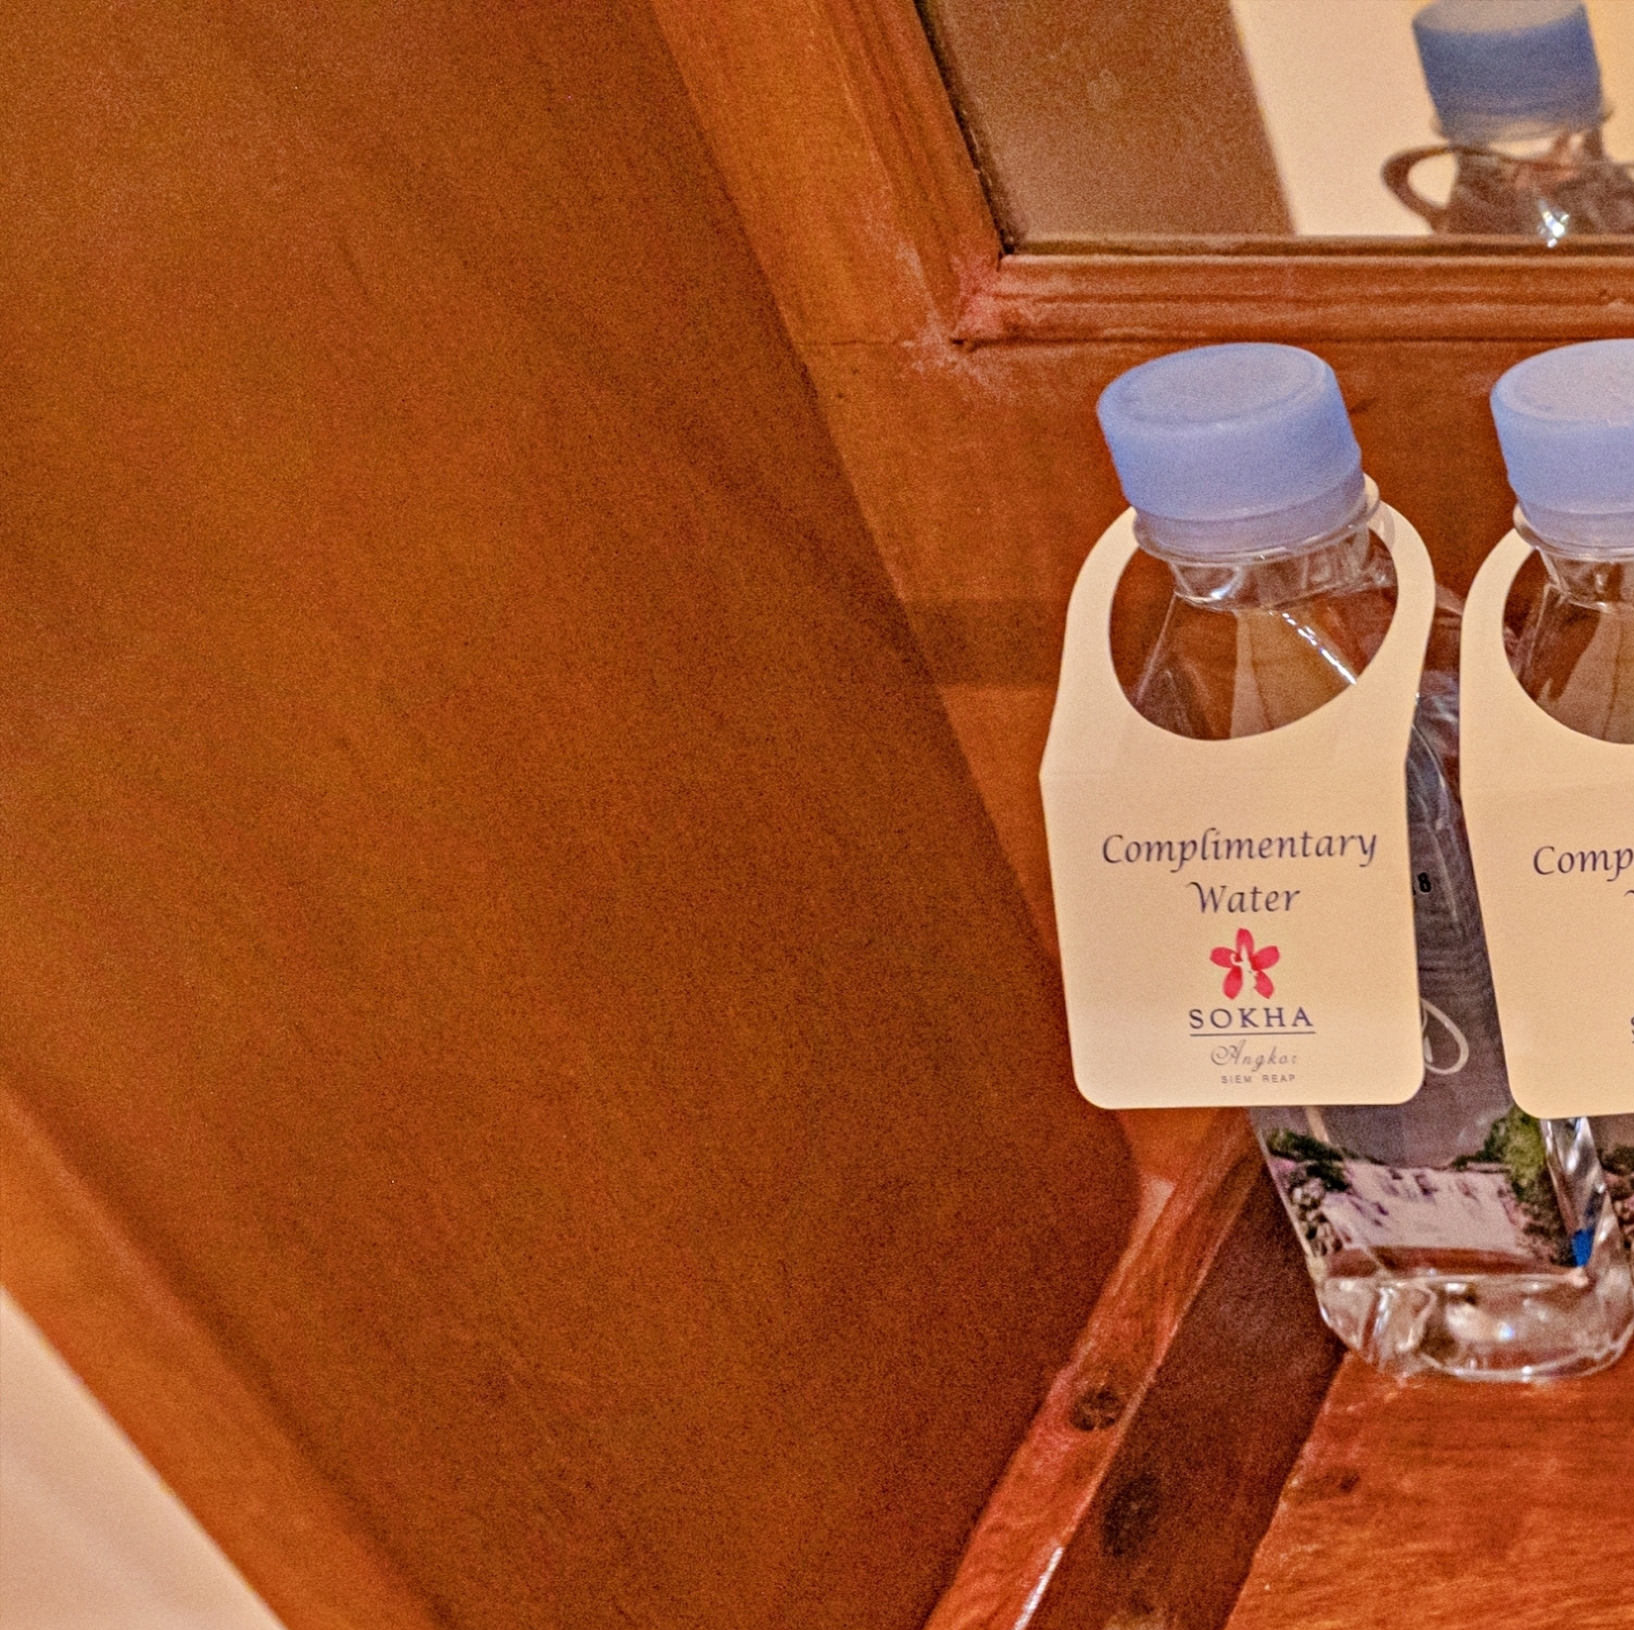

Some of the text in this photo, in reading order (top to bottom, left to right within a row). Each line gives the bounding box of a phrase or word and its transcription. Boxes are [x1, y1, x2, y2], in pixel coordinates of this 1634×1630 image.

[1102, 827, 1377, 873] Complimentary
[1185, 880, 1301, 914] Water
[1188, 1006, 1314, 1030] SOKHA
[1210, 1039, 1298, 1072] Angkor
[1220, 1073, 1296, 1084] SIEM REAP
